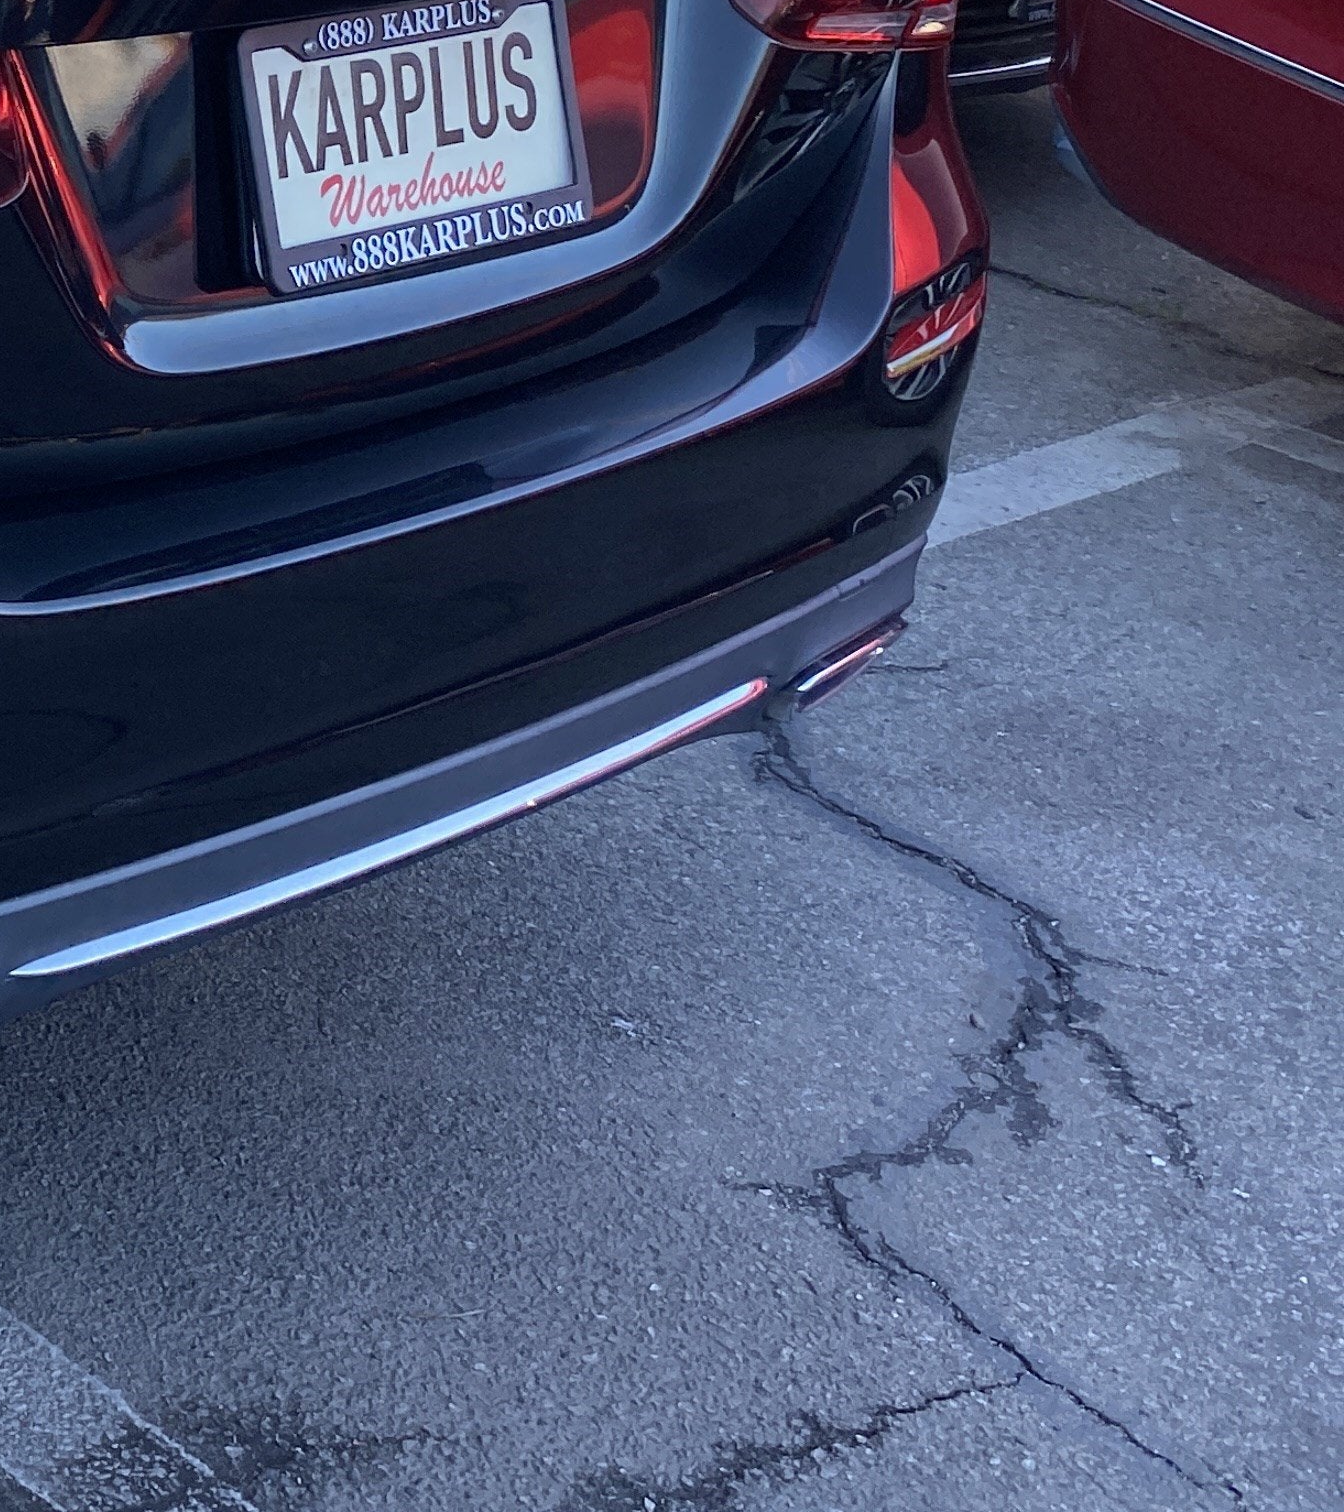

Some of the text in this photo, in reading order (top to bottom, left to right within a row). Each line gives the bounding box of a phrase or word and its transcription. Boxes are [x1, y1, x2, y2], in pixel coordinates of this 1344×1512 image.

[317, 16, 376, 52] (888)
[267, 31, 539, 180] KARPLUS
[319, 150, 508, 229] Warehouse
